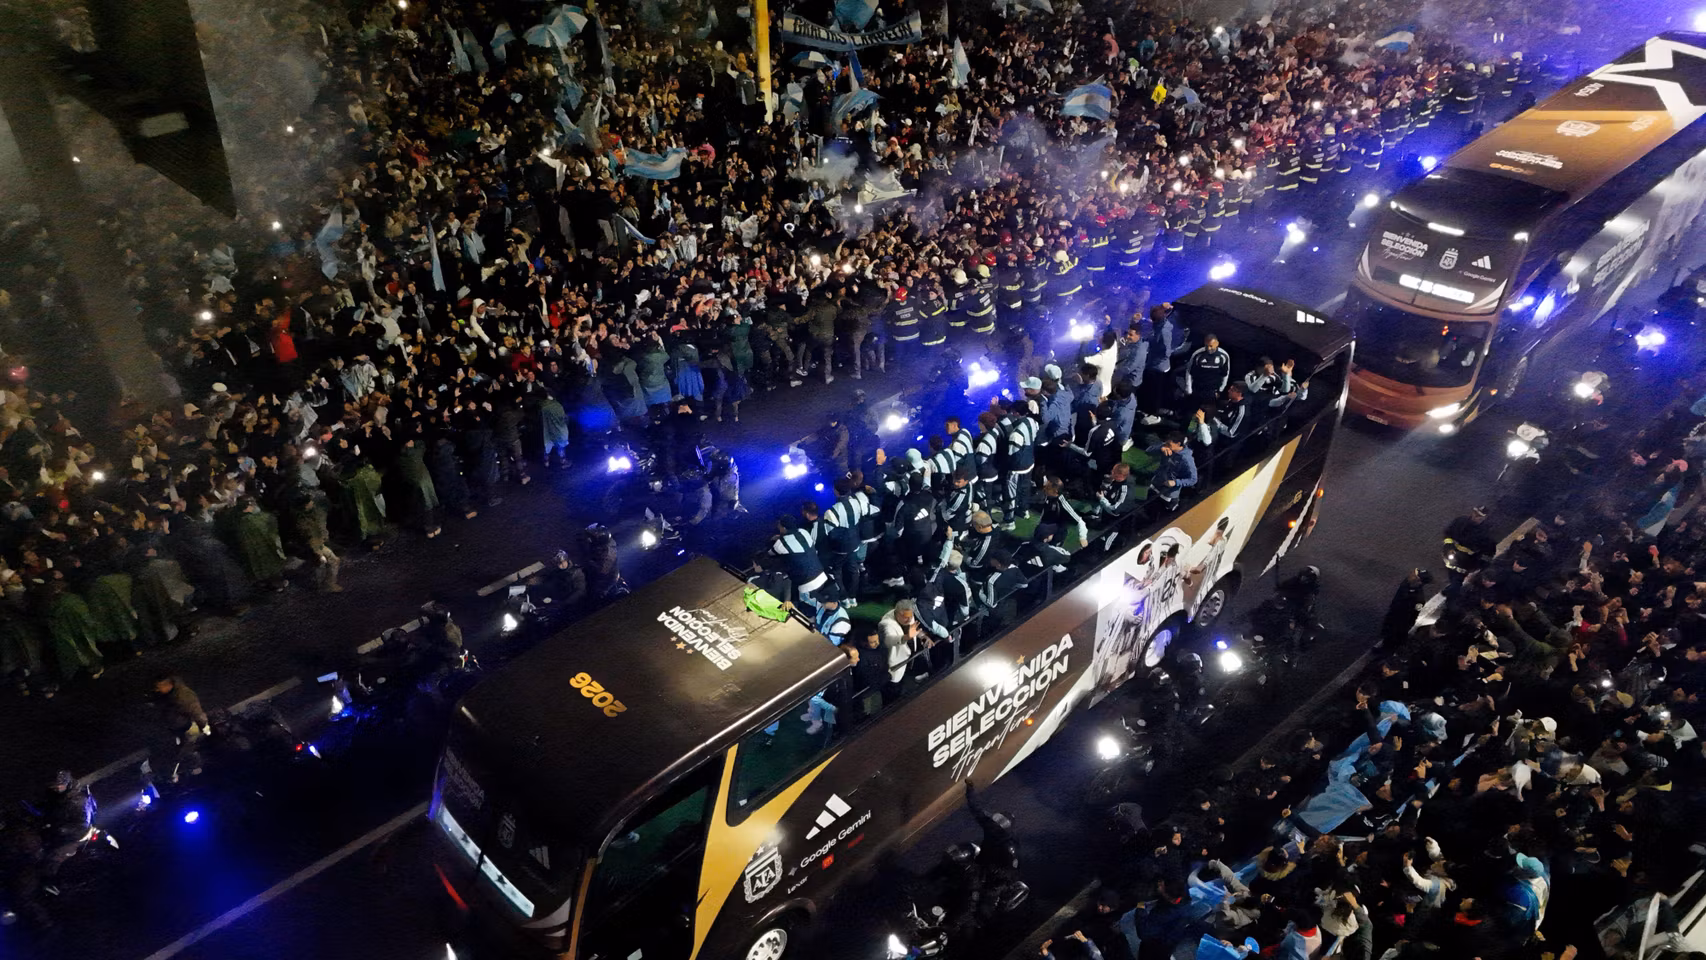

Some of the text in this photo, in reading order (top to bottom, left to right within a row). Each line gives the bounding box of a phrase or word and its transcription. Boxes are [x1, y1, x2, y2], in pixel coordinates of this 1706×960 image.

[1383, 231, 1428, 251] BIENVENIDA
[656, 611, 733, 671] BIENVENIDA
[569, 672, 627, 717] 2026
[928, 633, 1074, 752] BIENVENIDA
[800, 838, 837, 868] Google
[838, 810, 871, 841] Gemini
